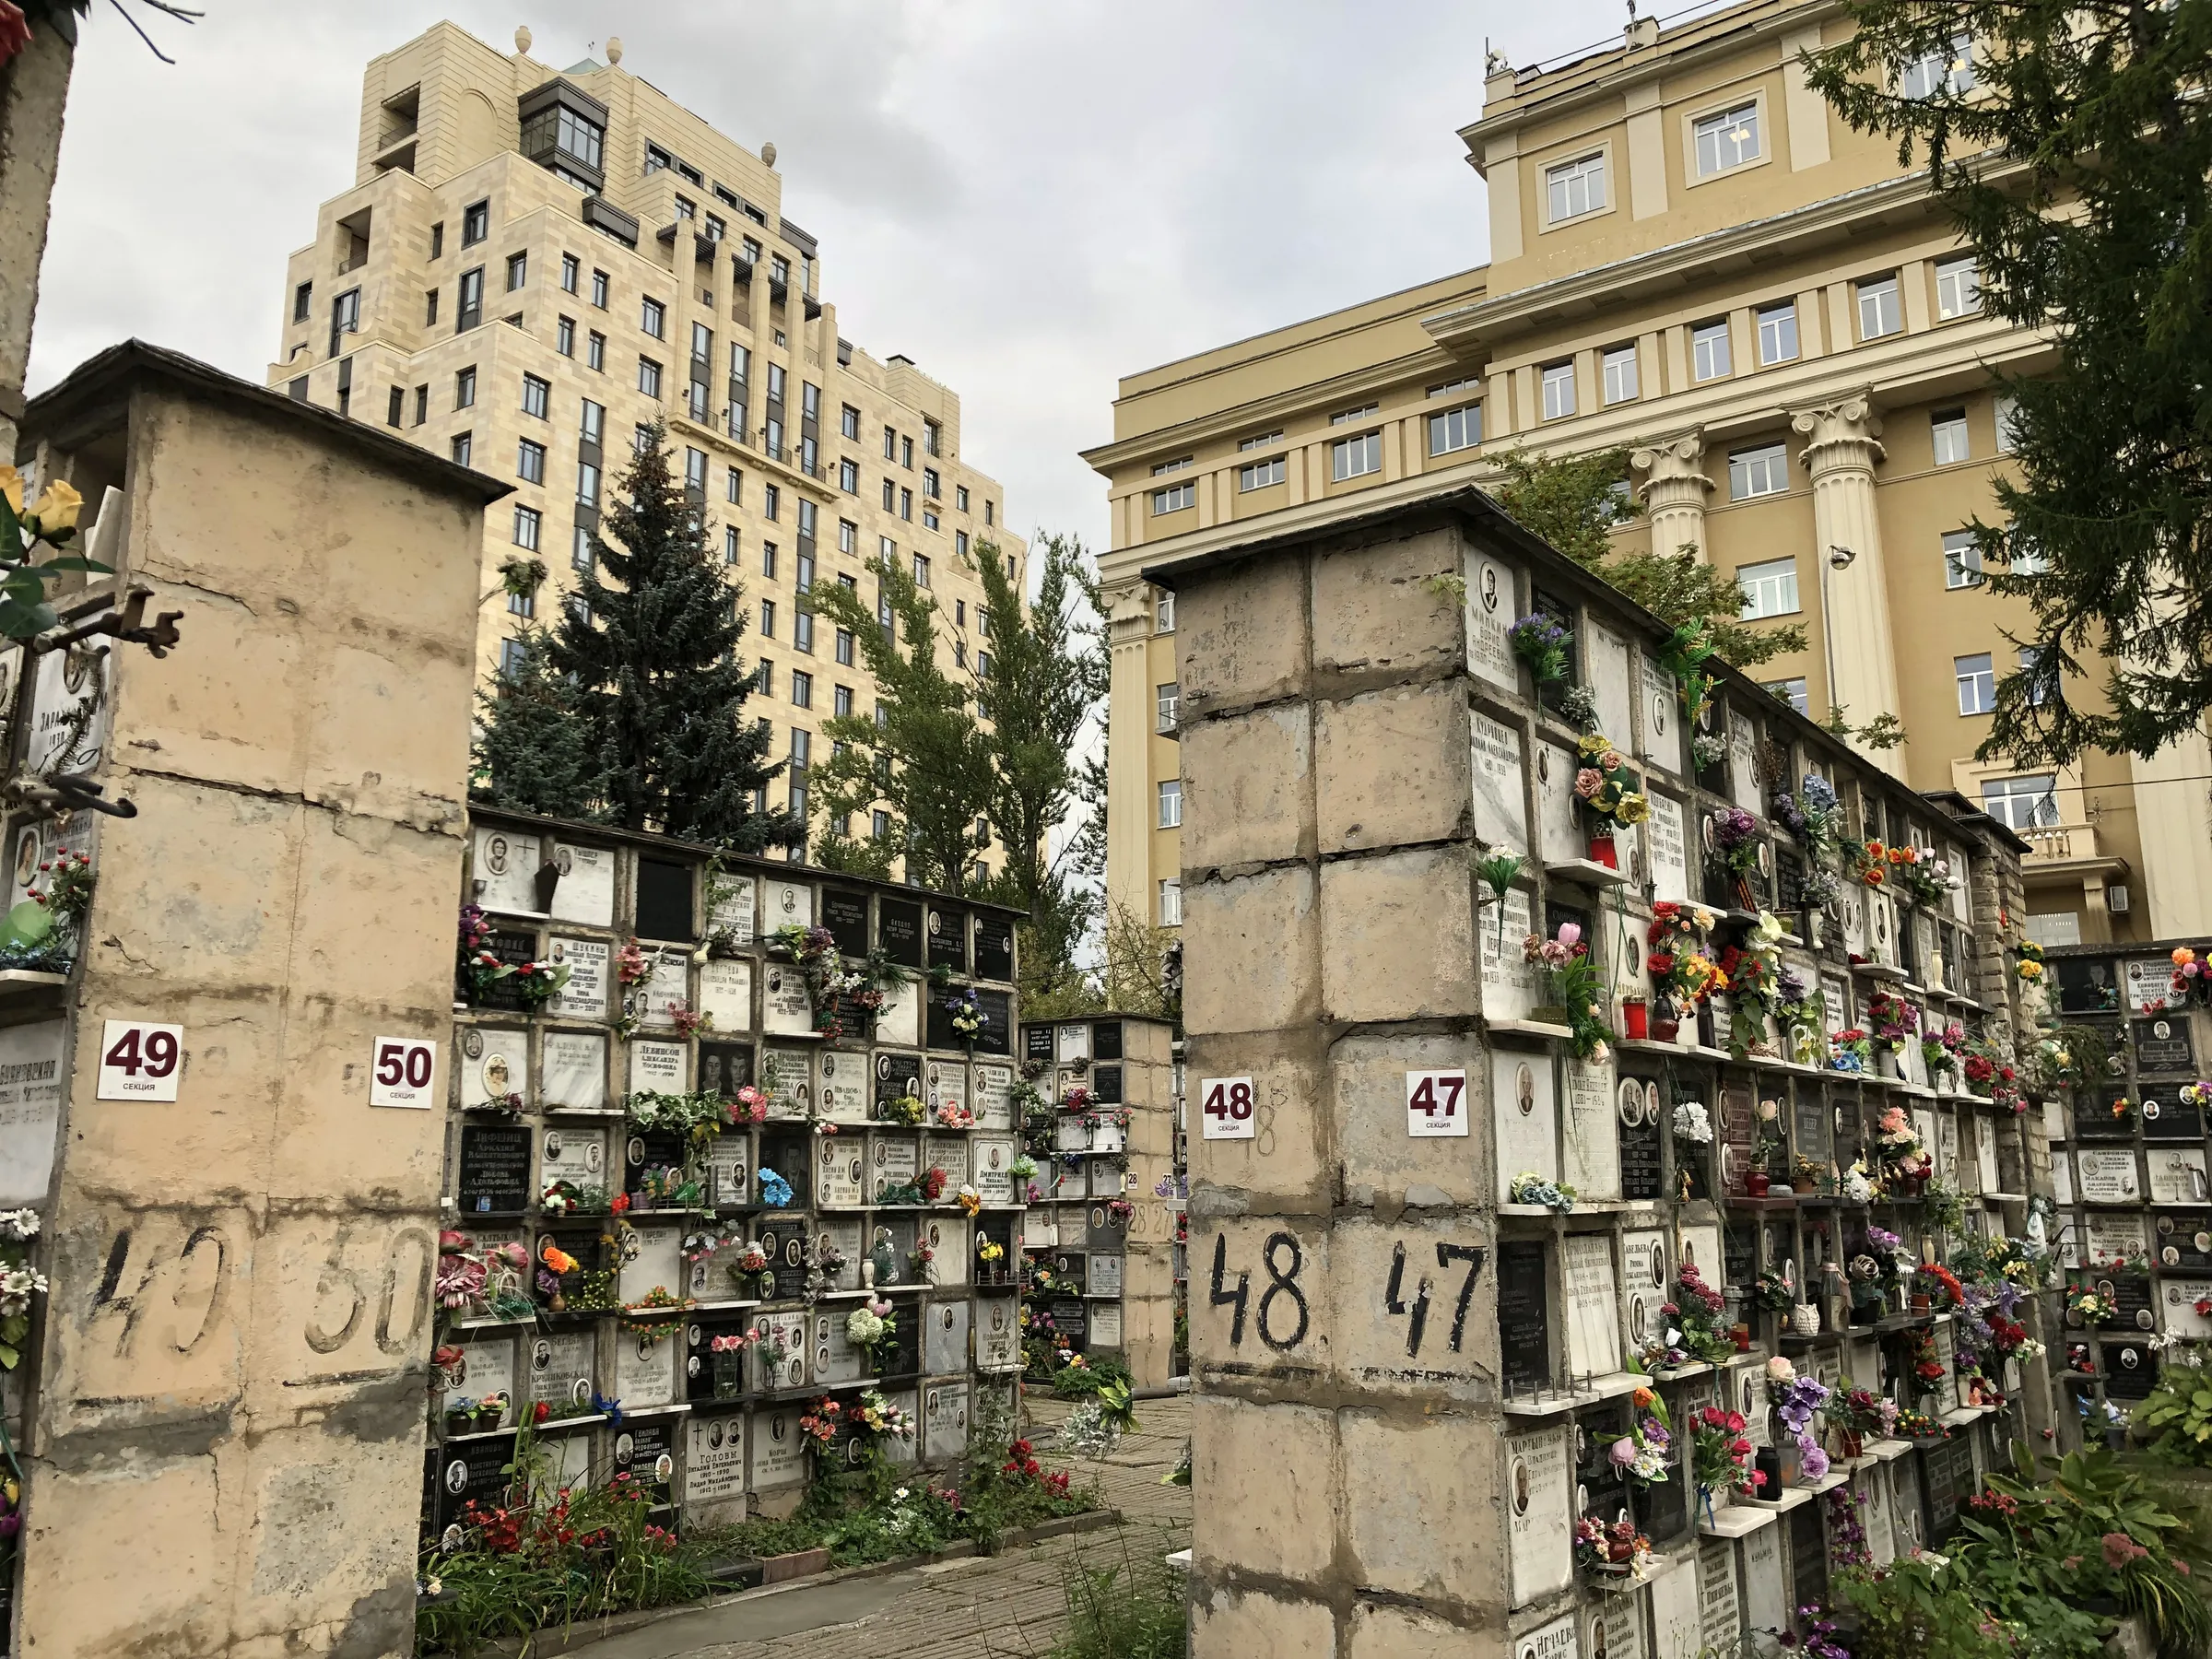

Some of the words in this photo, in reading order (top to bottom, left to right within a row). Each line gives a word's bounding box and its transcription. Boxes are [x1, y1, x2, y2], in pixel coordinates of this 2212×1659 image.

[1472, 605, 1508, 639] МИНКИН
[105, 1029, 179, 1078] 49
[640, 1045, 680, 1056] ЛЕВИНСОН
[376, 1044, 432, 1088] 50
[123, 1081, 156, 1092] СЕКЦИЯ
[389, 1091, 416, 1100] СЕКЦИЯ
[1204, 1082, 1253, 1121] 48
[1410, 1077, 1465, 1118] 47
[1426, 1122, 1451, 1130] СЕКЦИЯ
[474, 1132, 522, 1143] ЛИФШИЦ
[1128, 1173, 1137, 1184] 28
[1210, 1231, 1310, 1352] 48
[1385, 1240, 1488, 1359] 47
[700, 1451, 737, 1464] ГОЛОВЫ
[688, 1464, 710, 1474] ВИТАЛИЙ
